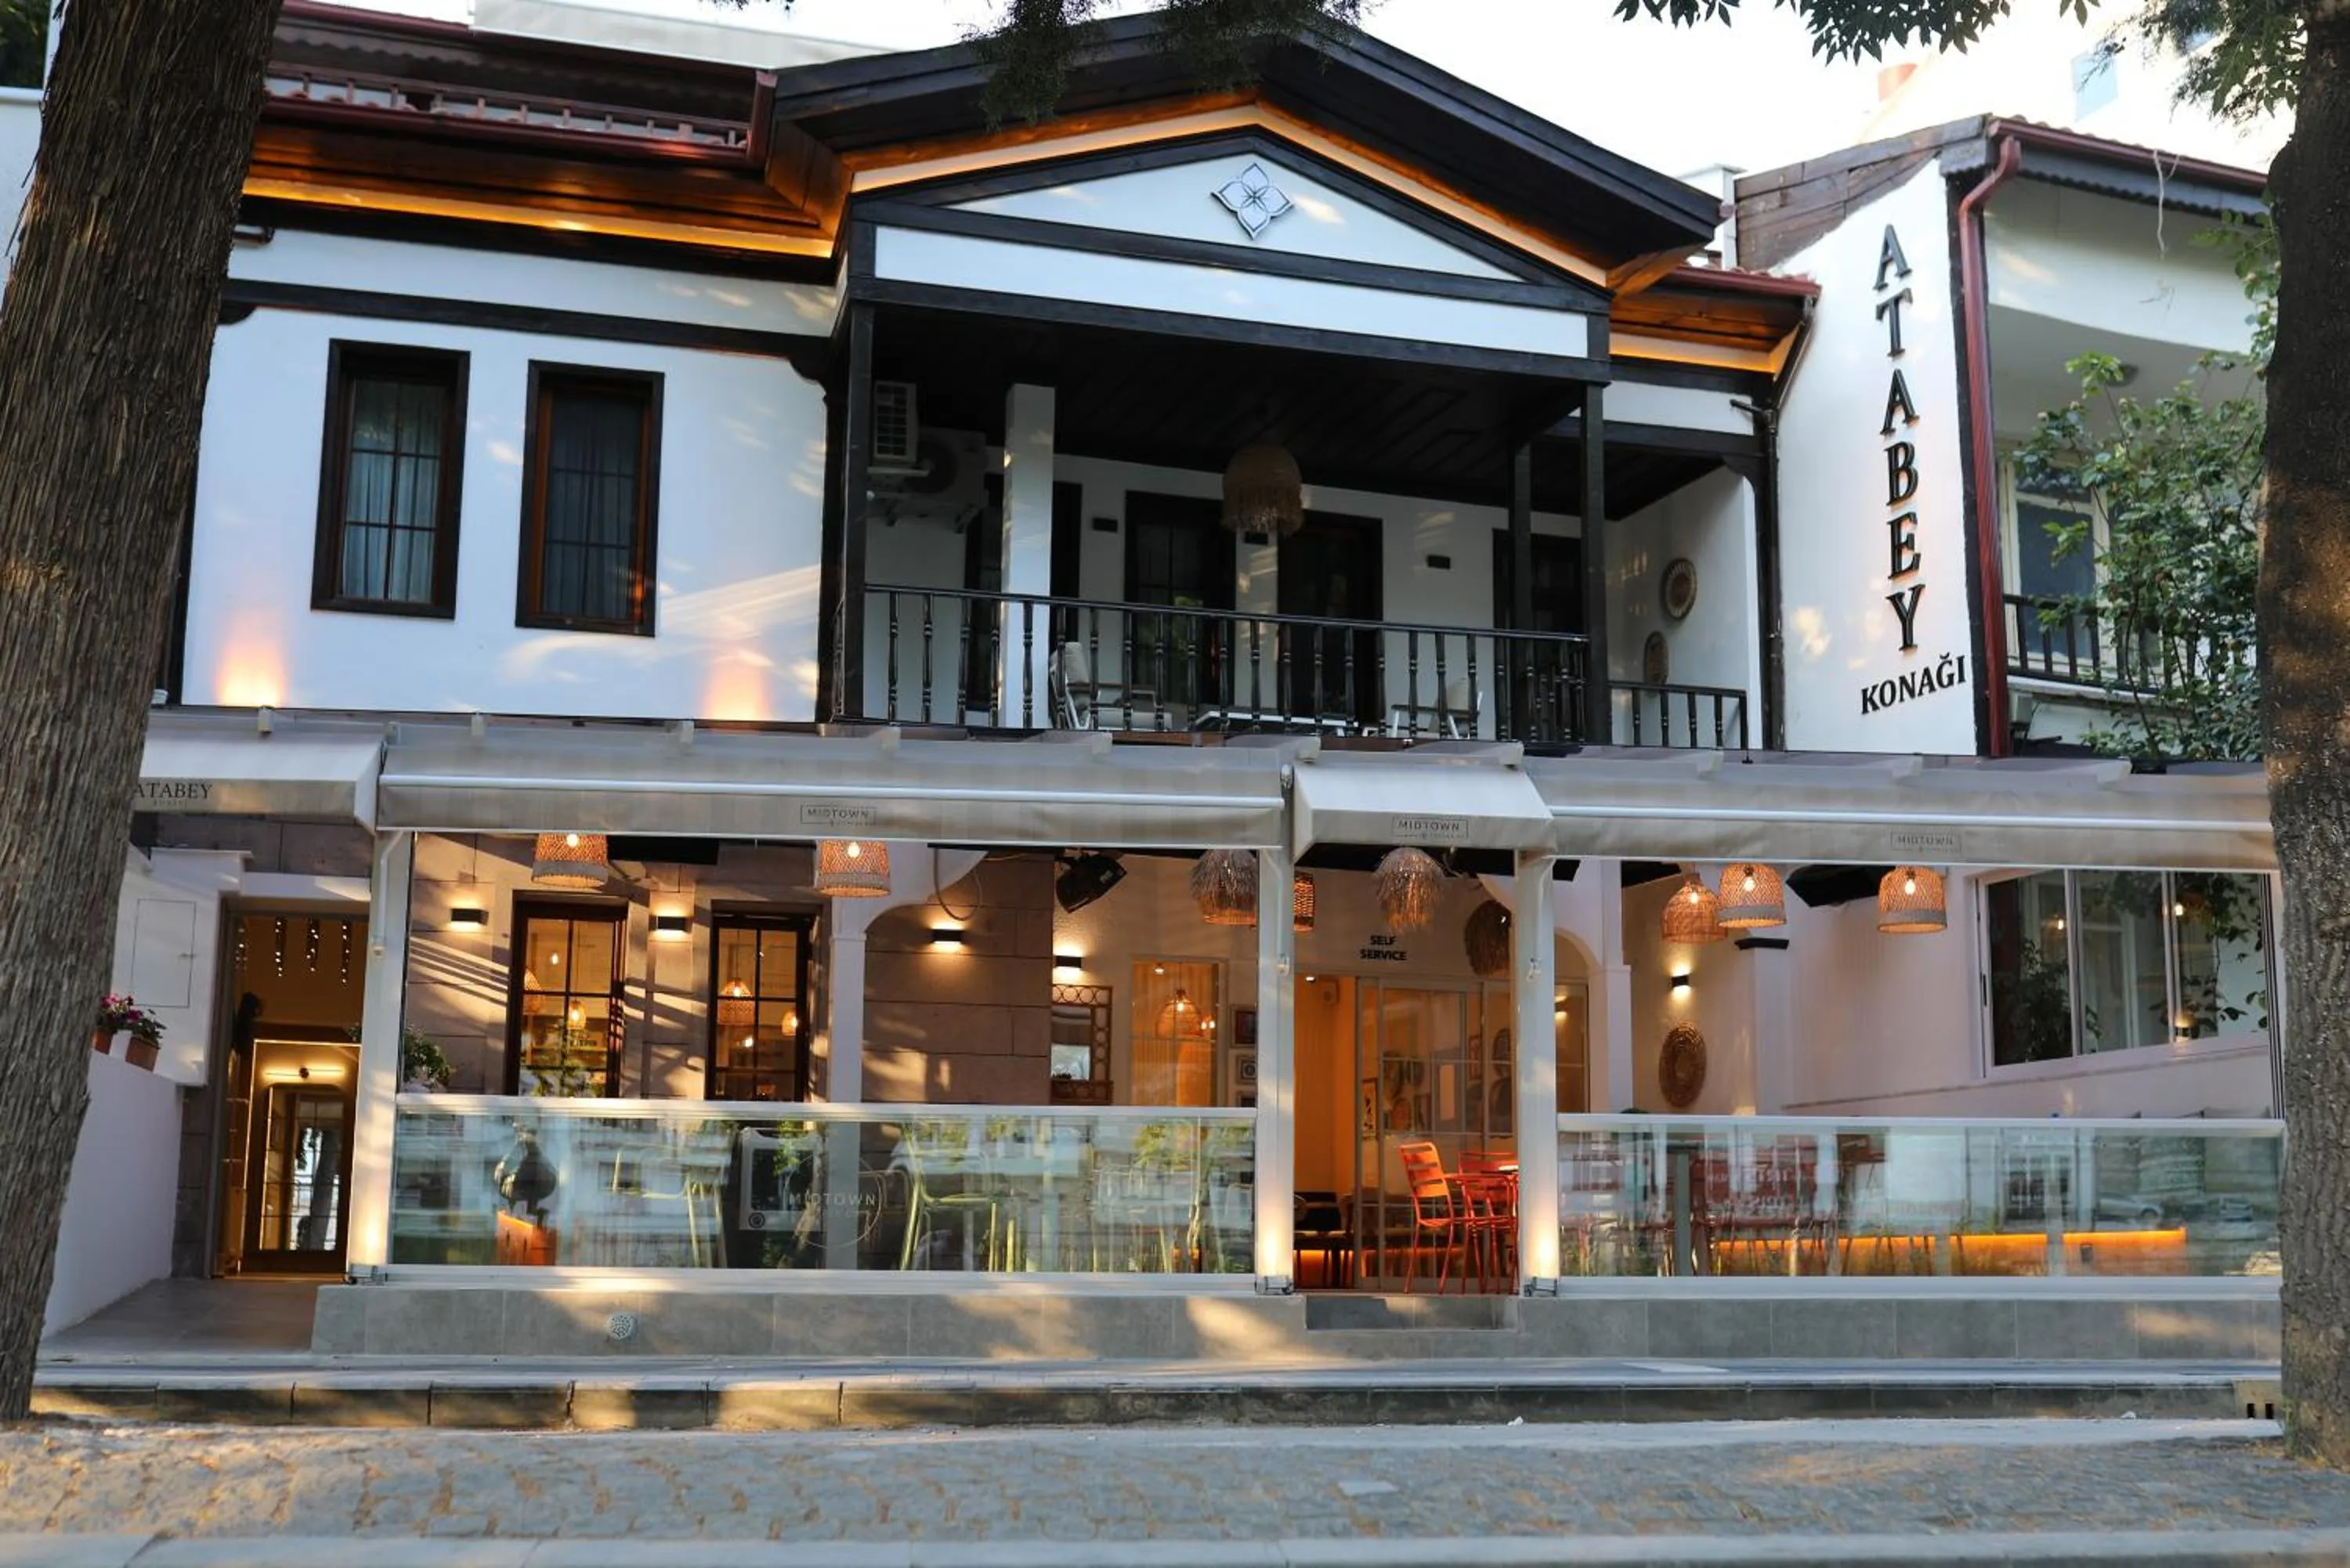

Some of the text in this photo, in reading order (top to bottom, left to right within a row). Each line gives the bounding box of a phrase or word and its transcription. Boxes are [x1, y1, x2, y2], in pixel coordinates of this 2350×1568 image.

[1873, 224, 1925, 653] ATABEY
[1861, 652, 1966, 714] KONAĞI
[808, 807, 869, 818] MIDTOWN
[1398, 820, 1459, 831] MIDTOWN
[1898, 835, 1954, 845] MIDTOWN
[1370, 934, 1397, 945] SELF
[1360, 948, 1408, 960] SERVICE
